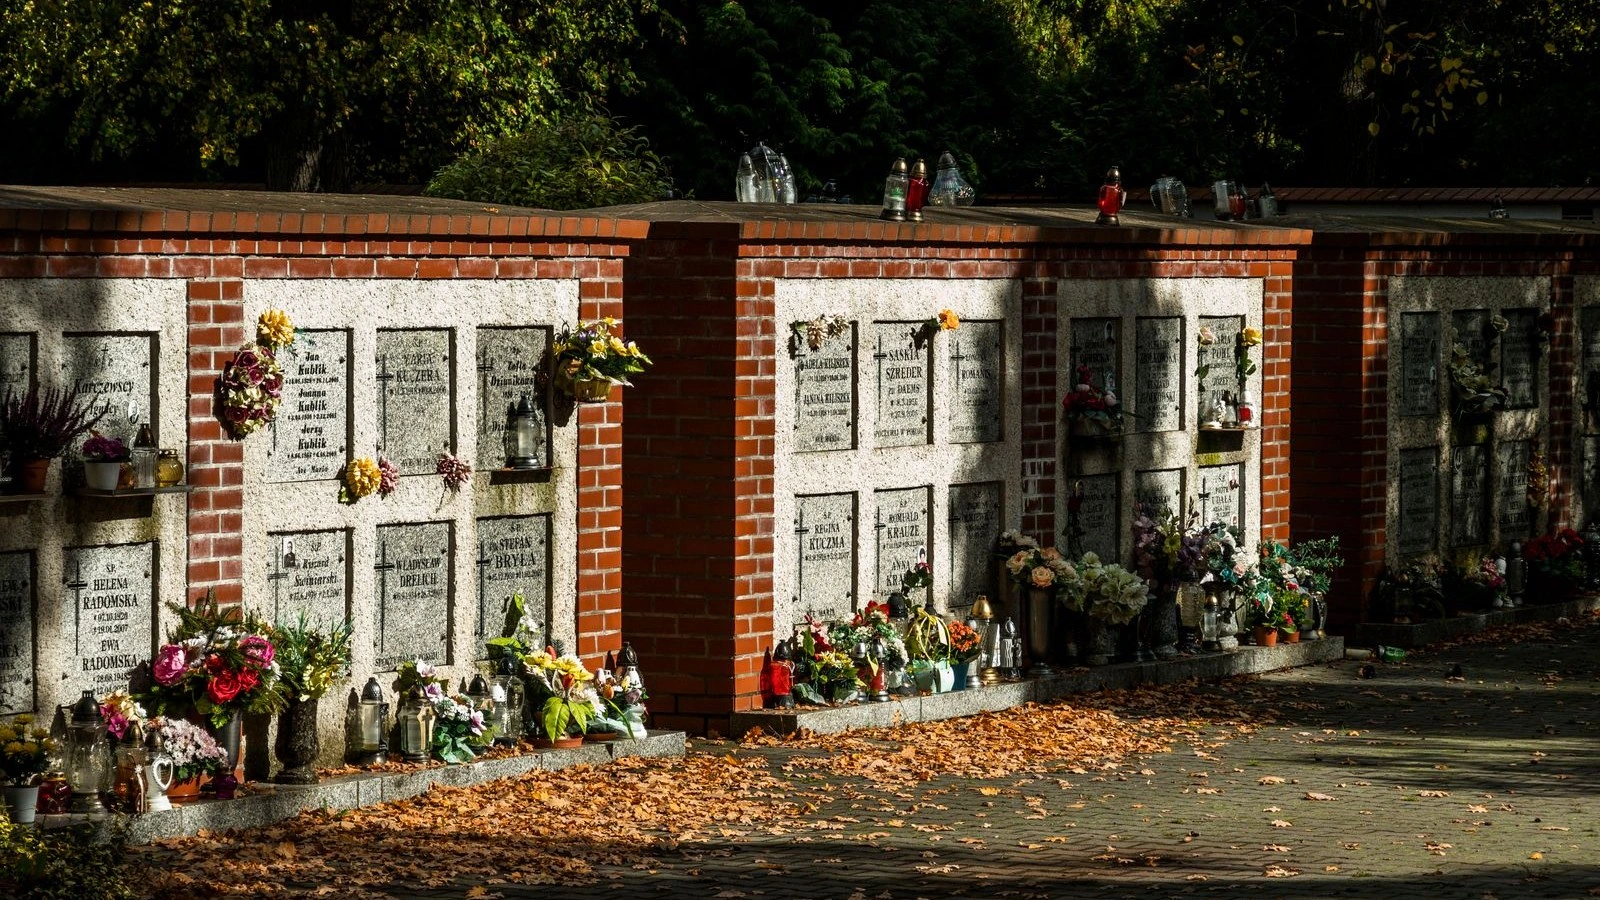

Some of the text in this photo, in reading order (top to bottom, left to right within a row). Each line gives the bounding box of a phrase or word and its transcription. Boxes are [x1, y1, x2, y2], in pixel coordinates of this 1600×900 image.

[305, 351, 320, 361] Jan
[298, 364, 328, 376] Kublik
[885, 366, 922, 380] SZREDER
[298, 401, 328, 413] Kublik
[301, 424, 324, 436] Jerzy
[298, 438, 328, 450] Kublik
[814, 523, 841, 535] REGINA
[887, 525, 920, 539] KRAUZE
[499, 536, 532, 551] STEFAN
[809, 536, 846, 551] KUCZMA
[93, 577, 129, 592] HELENA
[400, 573, 438, 587] DRELICH
[83, 594, 138, 610] RADOMSKA
[101, 640, 120, 652] EWA
[82, 654, 138, 671] RADOMSKA
